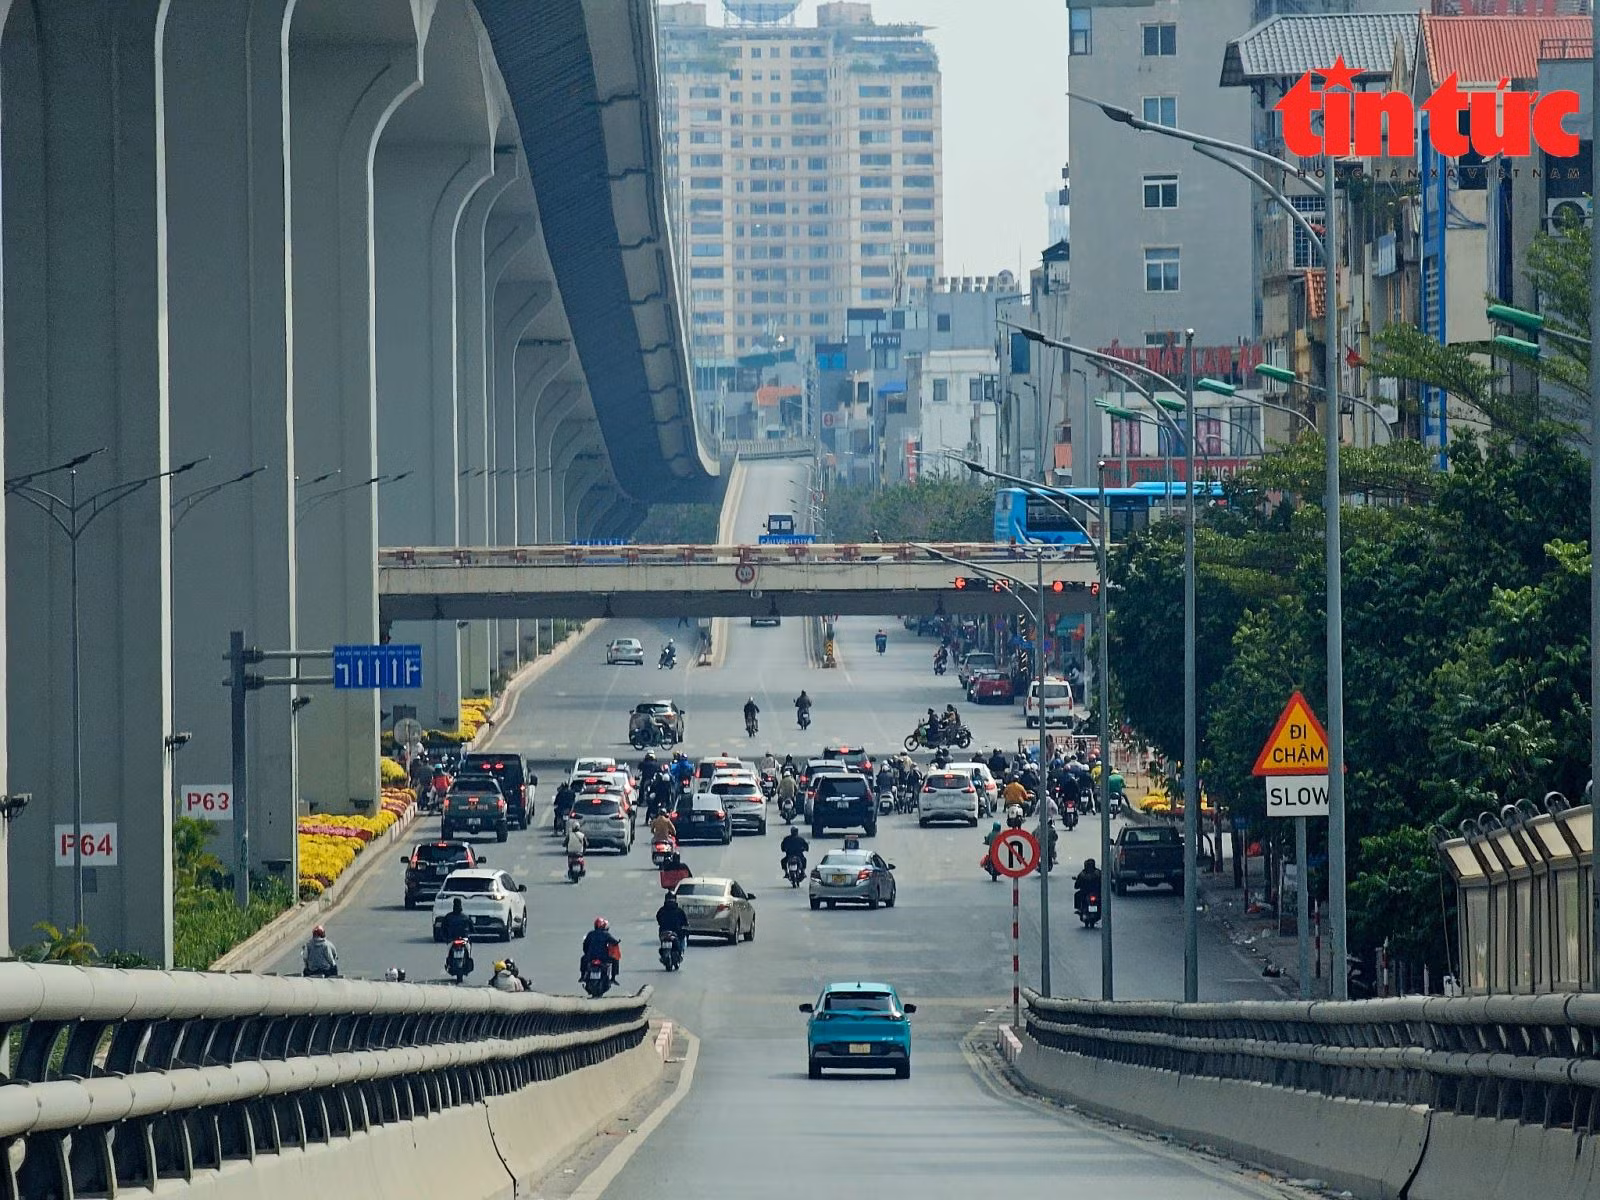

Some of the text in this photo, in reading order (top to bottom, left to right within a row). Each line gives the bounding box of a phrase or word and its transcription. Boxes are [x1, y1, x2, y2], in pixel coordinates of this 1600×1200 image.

[1290, 723, 1307, 740] ĐI
[1273, 743, 1324, 766] CHẬM
[187, 792, 230, 812] P63
[1270, 787, 1329, 806] SLOW
[61, 833, 113, 856] P64
